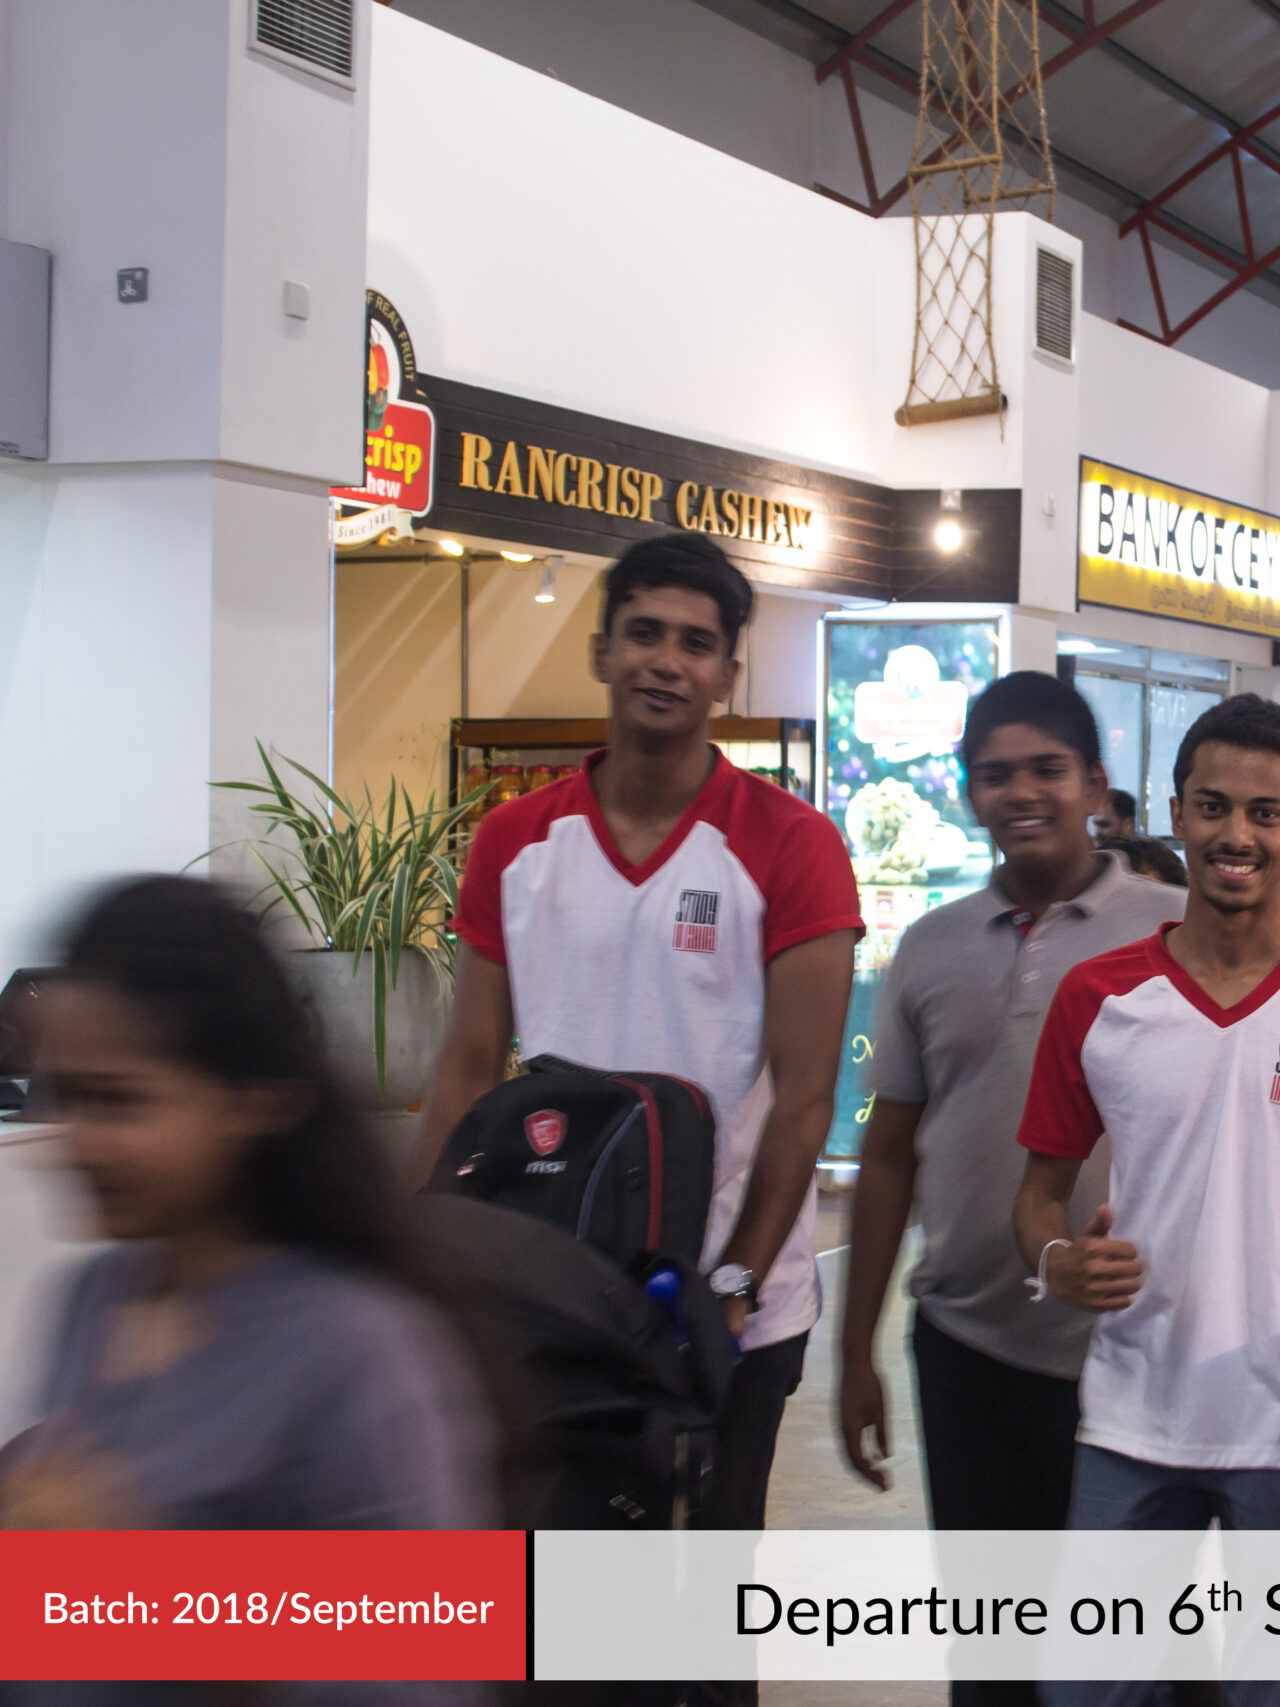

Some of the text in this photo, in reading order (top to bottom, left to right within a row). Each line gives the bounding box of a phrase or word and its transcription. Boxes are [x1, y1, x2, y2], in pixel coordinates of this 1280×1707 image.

[376, 296, 400, 331] REAL
[398, 331, 414, 382] FRUIT
[338, 510, 393, 538] Since 1981
[459, 432, 813, 549] RANCRISP CASHEW
[1098, 484, 1183, 572] BANK
[1191, 511, 1225, 581] OF
[676, 892, 718, 925] STUDY
